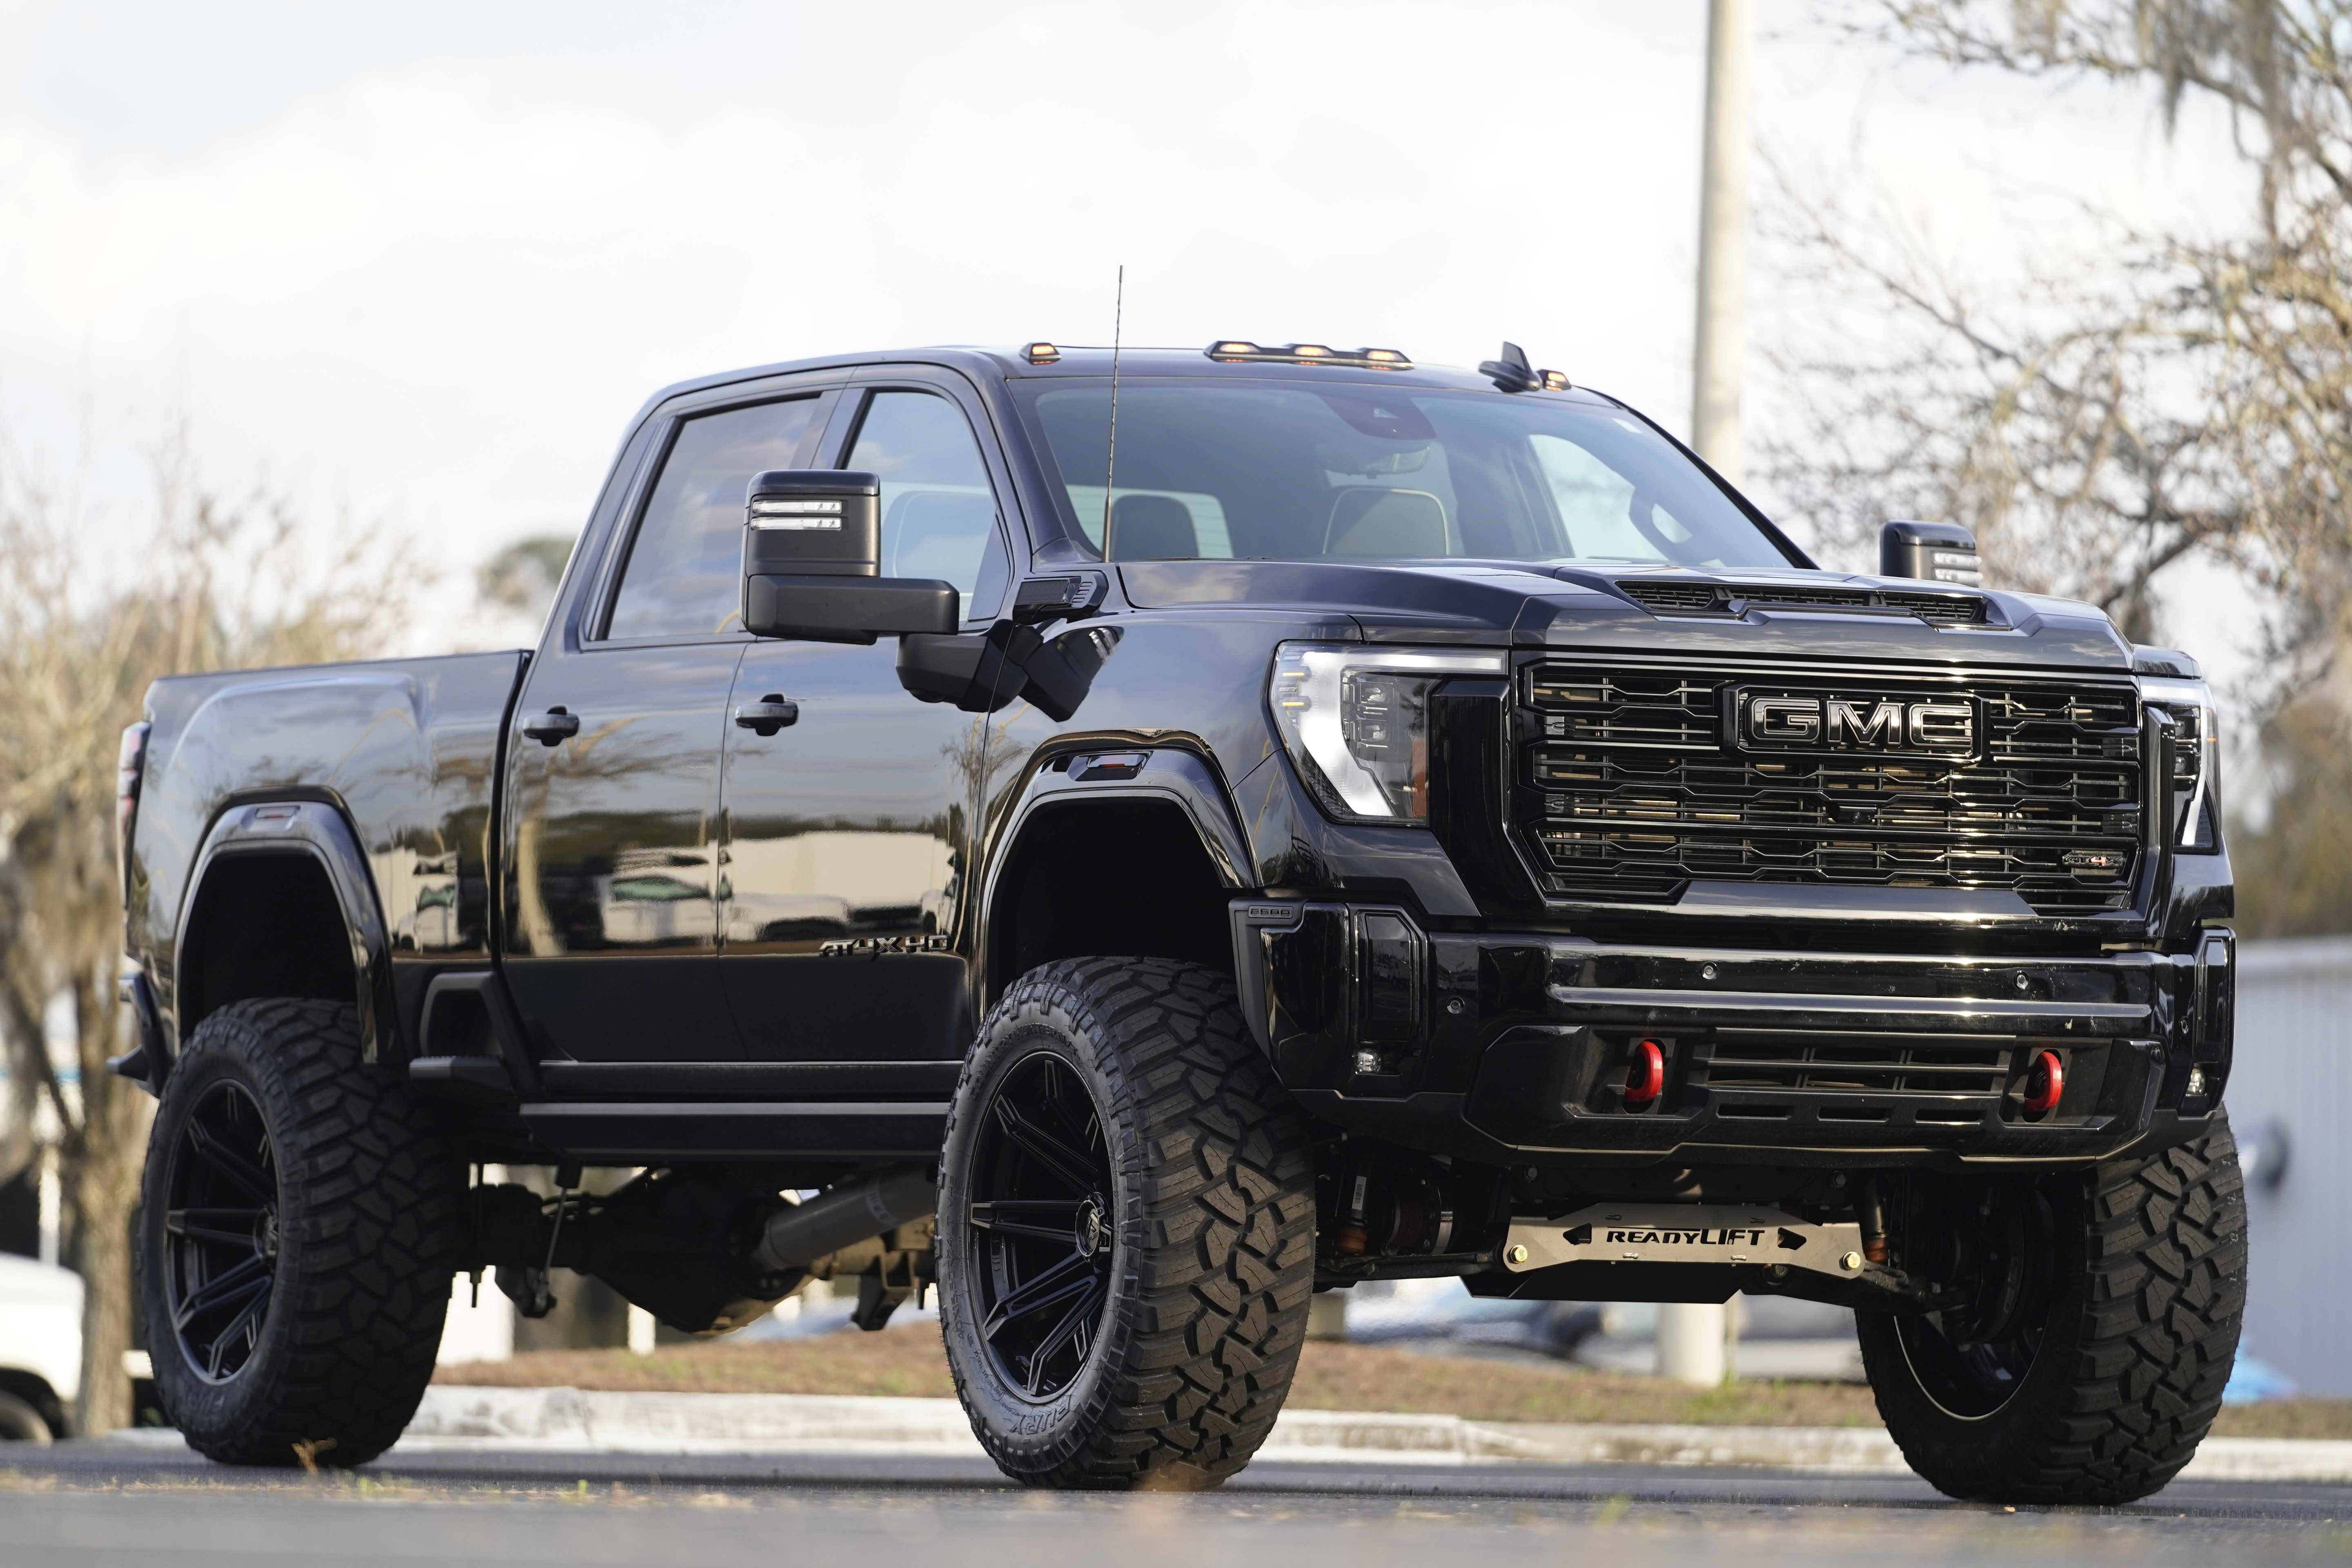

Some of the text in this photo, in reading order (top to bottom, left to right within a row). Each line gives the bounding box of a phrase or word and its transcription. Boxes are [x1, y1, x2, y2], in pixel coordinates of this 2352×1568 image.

[1748, 697, 1973, 748] GMC
[818, 935, 949, 957] AT4X HD
[1606, 1226, 1765, 1245] READYLIFT
[947, 1215, 964, 1339] 40X15.50R24LT
[1009, 1394, 1072, 1435] FURY
